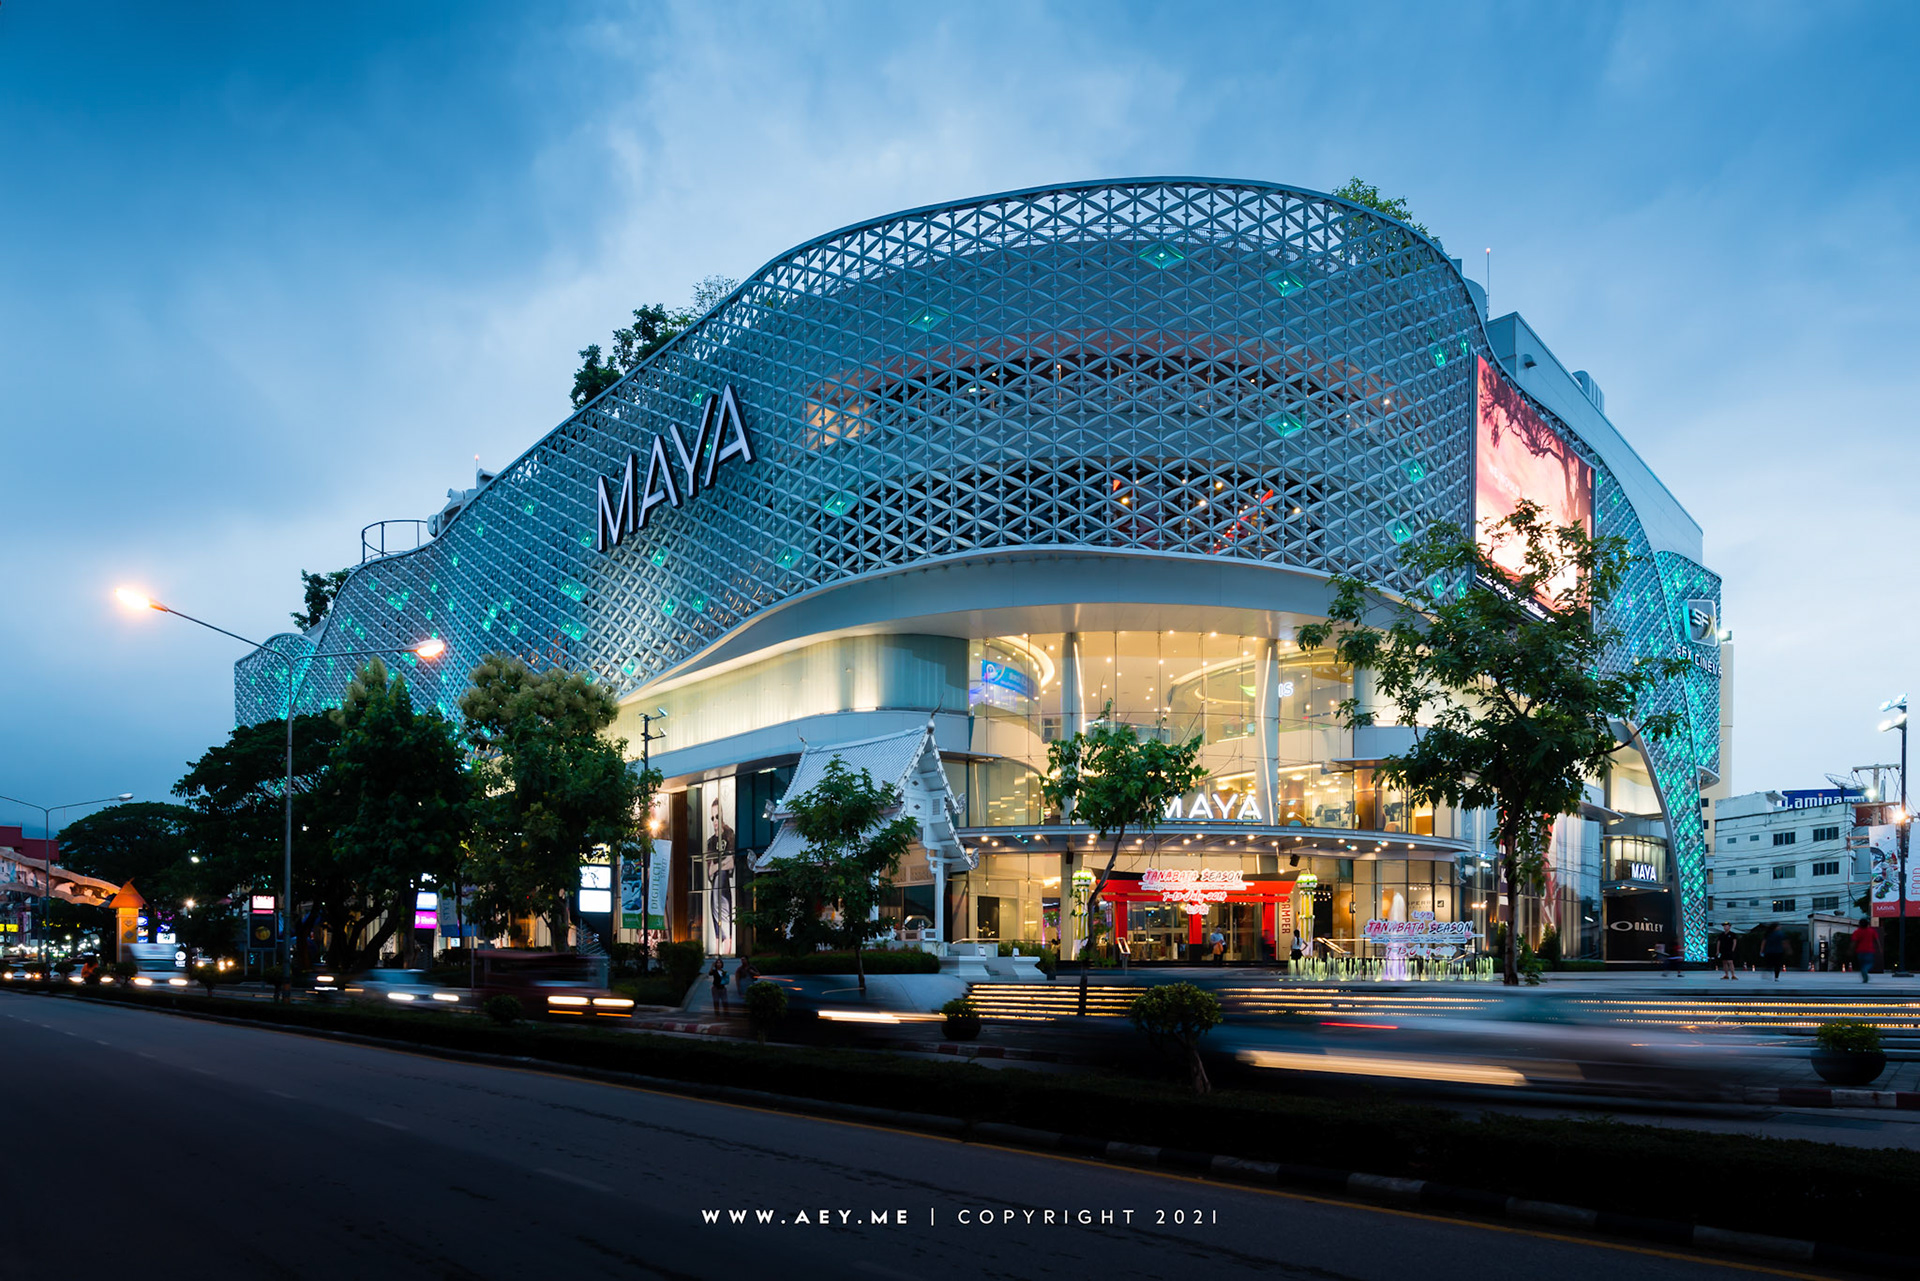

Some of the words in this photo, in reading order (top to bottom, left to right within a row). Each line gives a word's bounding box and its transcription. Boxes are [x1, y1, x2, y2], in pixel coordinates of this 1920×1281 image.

[597, 384, 756, 552] MAYA
[1160, 793, 1263, 820] MAYA
[1144, 869, 1199, 881] TANABATA
[1202, 869, 1243, 881] SEASON
[1631, 862, 1657, 881] MAYA
[650, 862, 662, 910] DIGITECH
[1428, 921, 1473, 933] SEASON
[1634, 921, 1664, 933] OAKLEY
